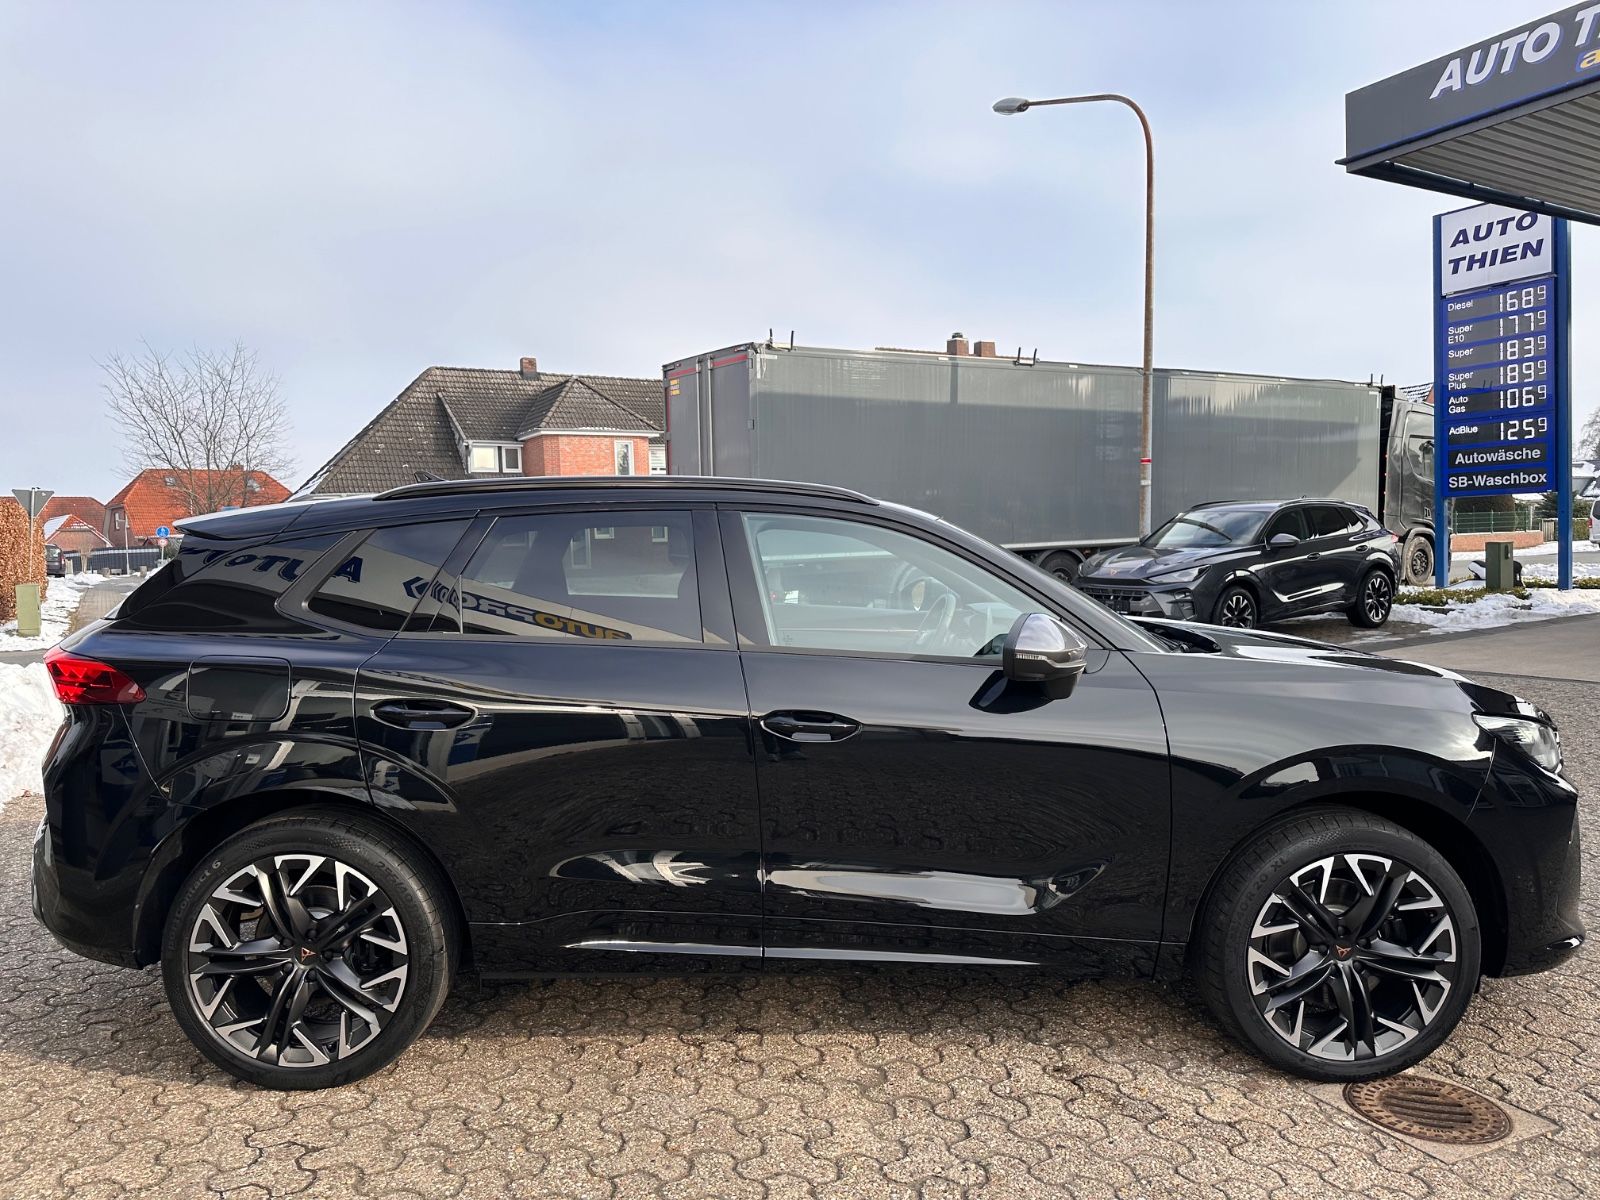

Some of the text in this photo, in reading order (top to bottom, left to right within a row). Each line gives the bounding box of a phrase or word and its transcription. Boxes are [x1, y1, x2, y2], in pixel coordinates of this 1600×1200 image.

[1429, 3, 1600, 100] AUTO T
[1450, 212, 1539, 248] AUTO
[1448, 238, 1545, 275] THIEN
[1447, 299, 1474, 311] Diesel
[1448, 324, 1473, 335] Super
[1448, 334, 1465, 344] E10
[1448, 347, 1474, 358] Super
[1448, 371, 1474, 382] Super
[1448, 382, 1467, 391] Plus
[1448, 396, 1469, 405] Auto
[1448, 405, 1466, 414] Gas
[1448, 425, 1479, 436] AdBlue
[1454, 447, 1542, 465] Autowäsche
[1448, 472, 1548, 488] SB-Waschbox
[211, 858, 222, 869] 6
